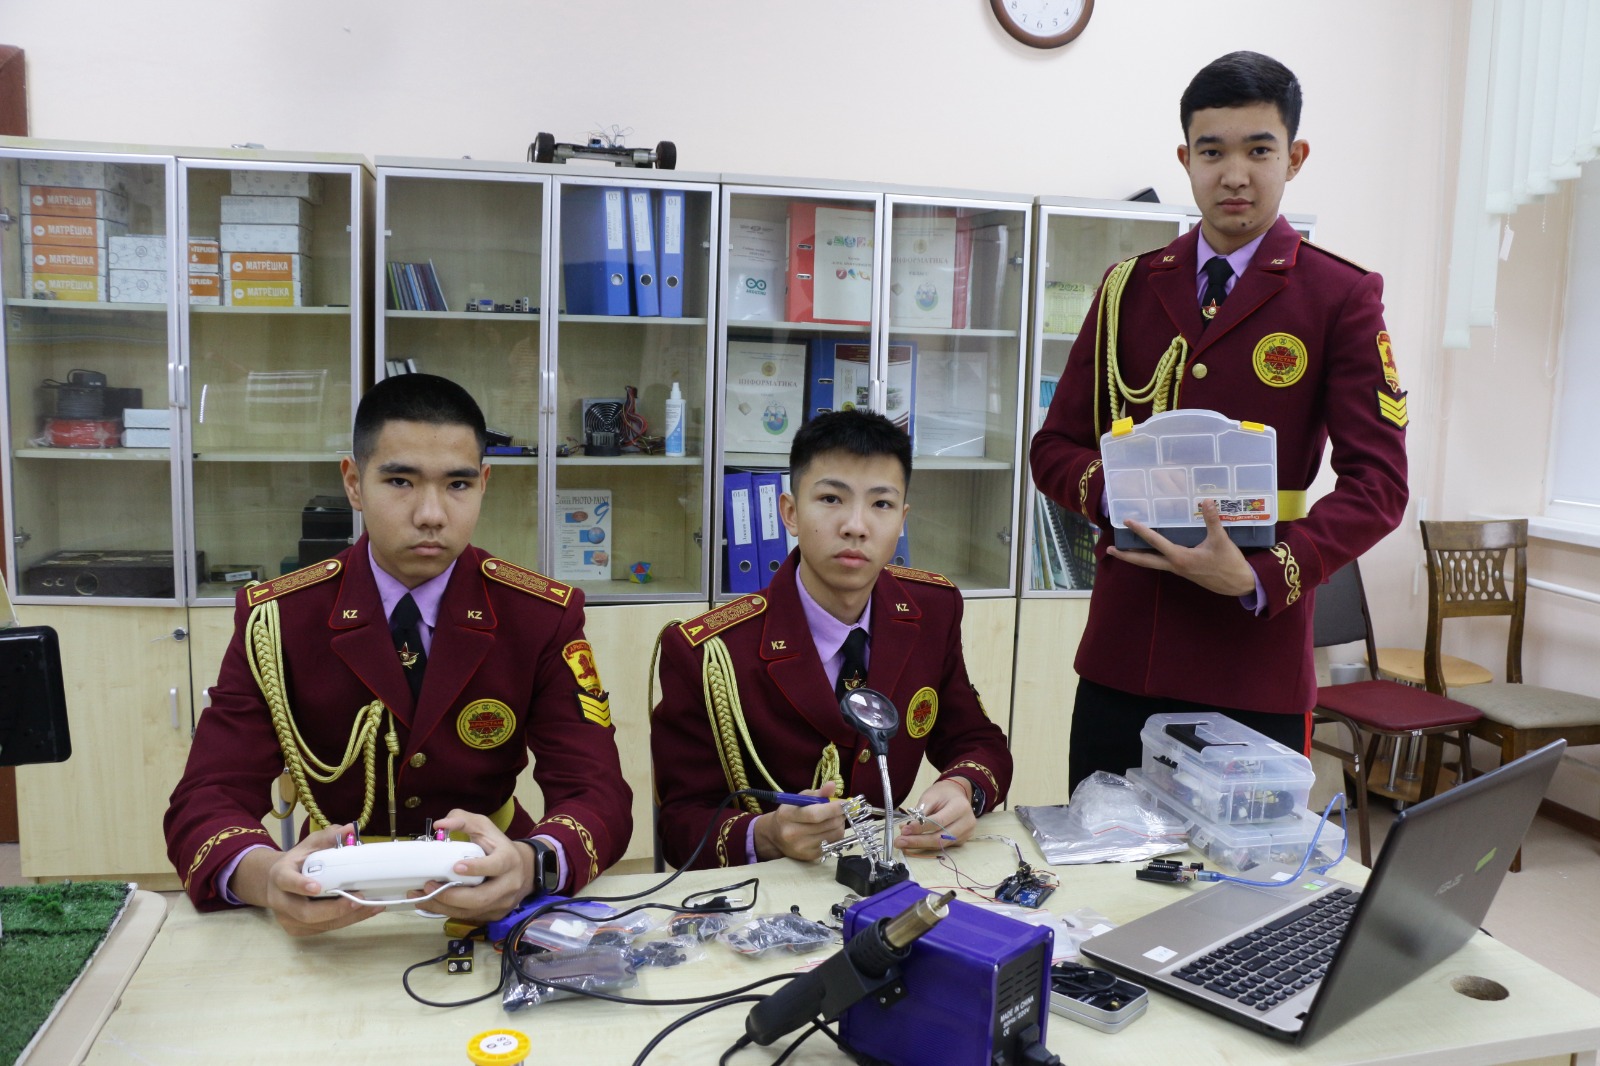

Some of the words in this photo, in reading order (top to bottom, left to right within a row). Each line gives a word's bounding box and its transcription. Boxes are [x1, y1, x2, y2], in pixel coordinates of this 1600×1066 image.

[1064, 8, 1069, 16] 4
[1022, 13, 1028, 22] 7
[1053, 17, 1058, 26] 5
[1036, 21, 1043, 29] 6
[47, 224, 93, 236] МАТРЁШКА
[49, 254, 94, 266] МАТРЁШКА
[1162, 255, 1175, 263] KZ
[245, 260, 288, 271] МАТРЁШКА
[247, 287, 290, 298] МАТРЁШКА
[1059, 283, 1086, 292] 2023
[738, 379, 798, 388] ИНФОРМАТИКА
[896, 603, 910, 612] KZ
[342, 609, 358, 619] KZ
[467, 609, 483, 620] KZ
[771, 640, 787, 650] KZ
[1434, 873, 1464, 897] ASUS
[1000, 1007, 1014, 1023] MADE
[1013, 1004, 1020, 1014] IN
[1020, 994, 1034, 1009] CHINA
[1002, 1026, 1010, 1037] CE
